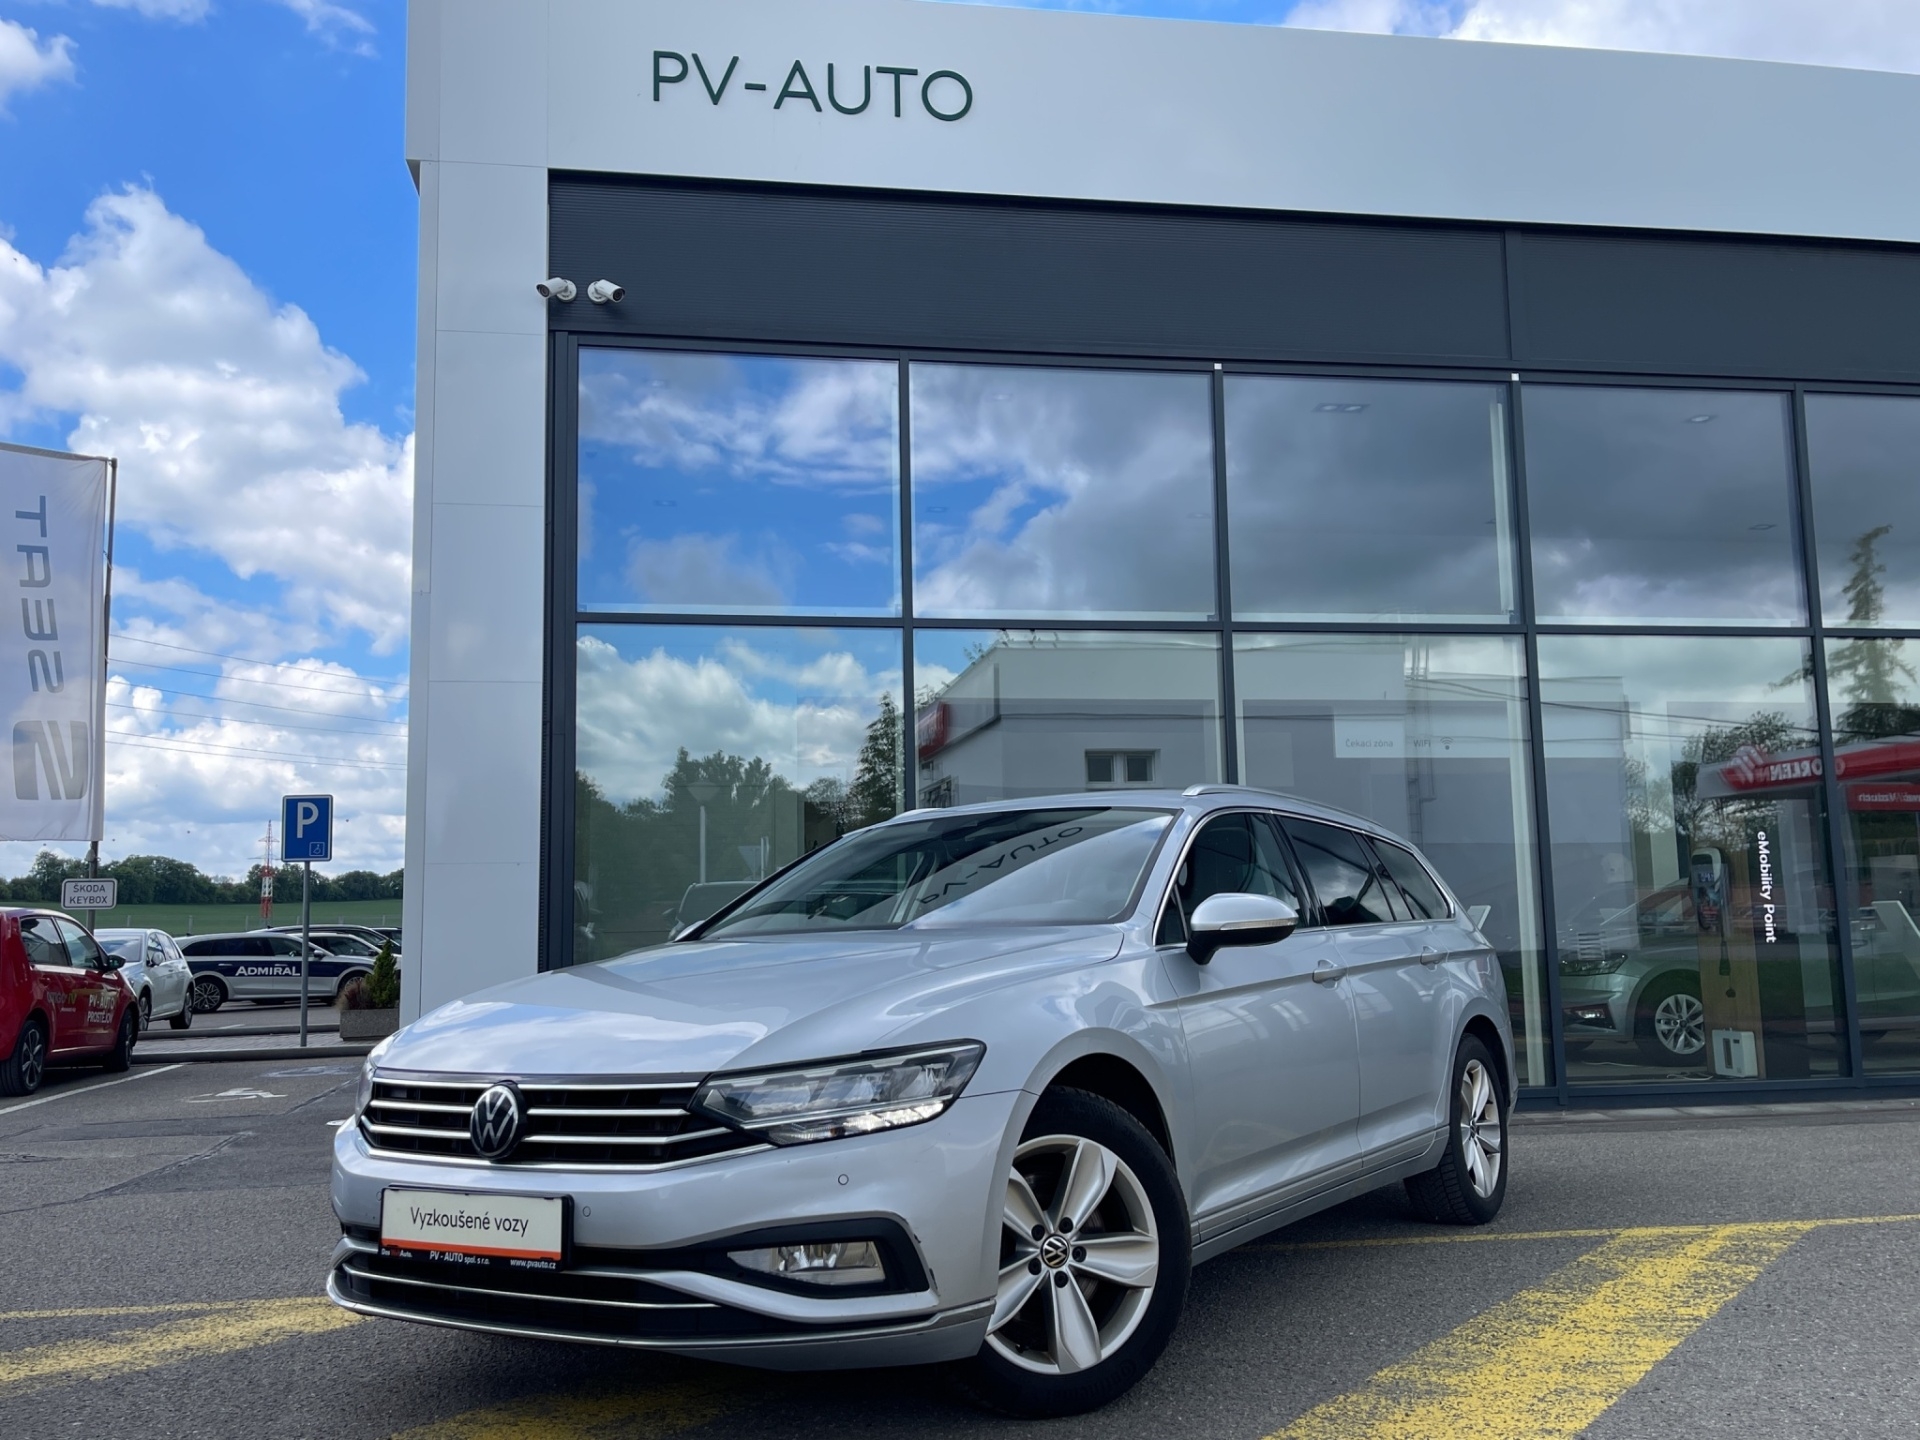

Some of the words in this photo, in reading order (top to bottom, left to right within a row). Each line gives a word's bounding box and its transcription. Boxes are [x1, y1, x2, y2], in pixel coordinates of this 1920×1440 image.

[653, 50, 973, 121] PV-AUTO
[297, 802, 319, 838] P
[1757, 831, 1773, 900] eMobility
[73, 882, 106, 893] ŠKODA
[69, 896, 108, 904] KEYBOX
[1763, 904, 1777, 943] Point
[235, 966, 300, 976] ADMIRAL
[410, 1206, 490, 1231] Vyzkoušené
[494, 1217, 529, 1237] vozy
[429, 1250, 440, 1260] PV
[443, 1252, 464, 1262] AUTO
[510, 1259, 557, 1270] www.pvauto.cz
